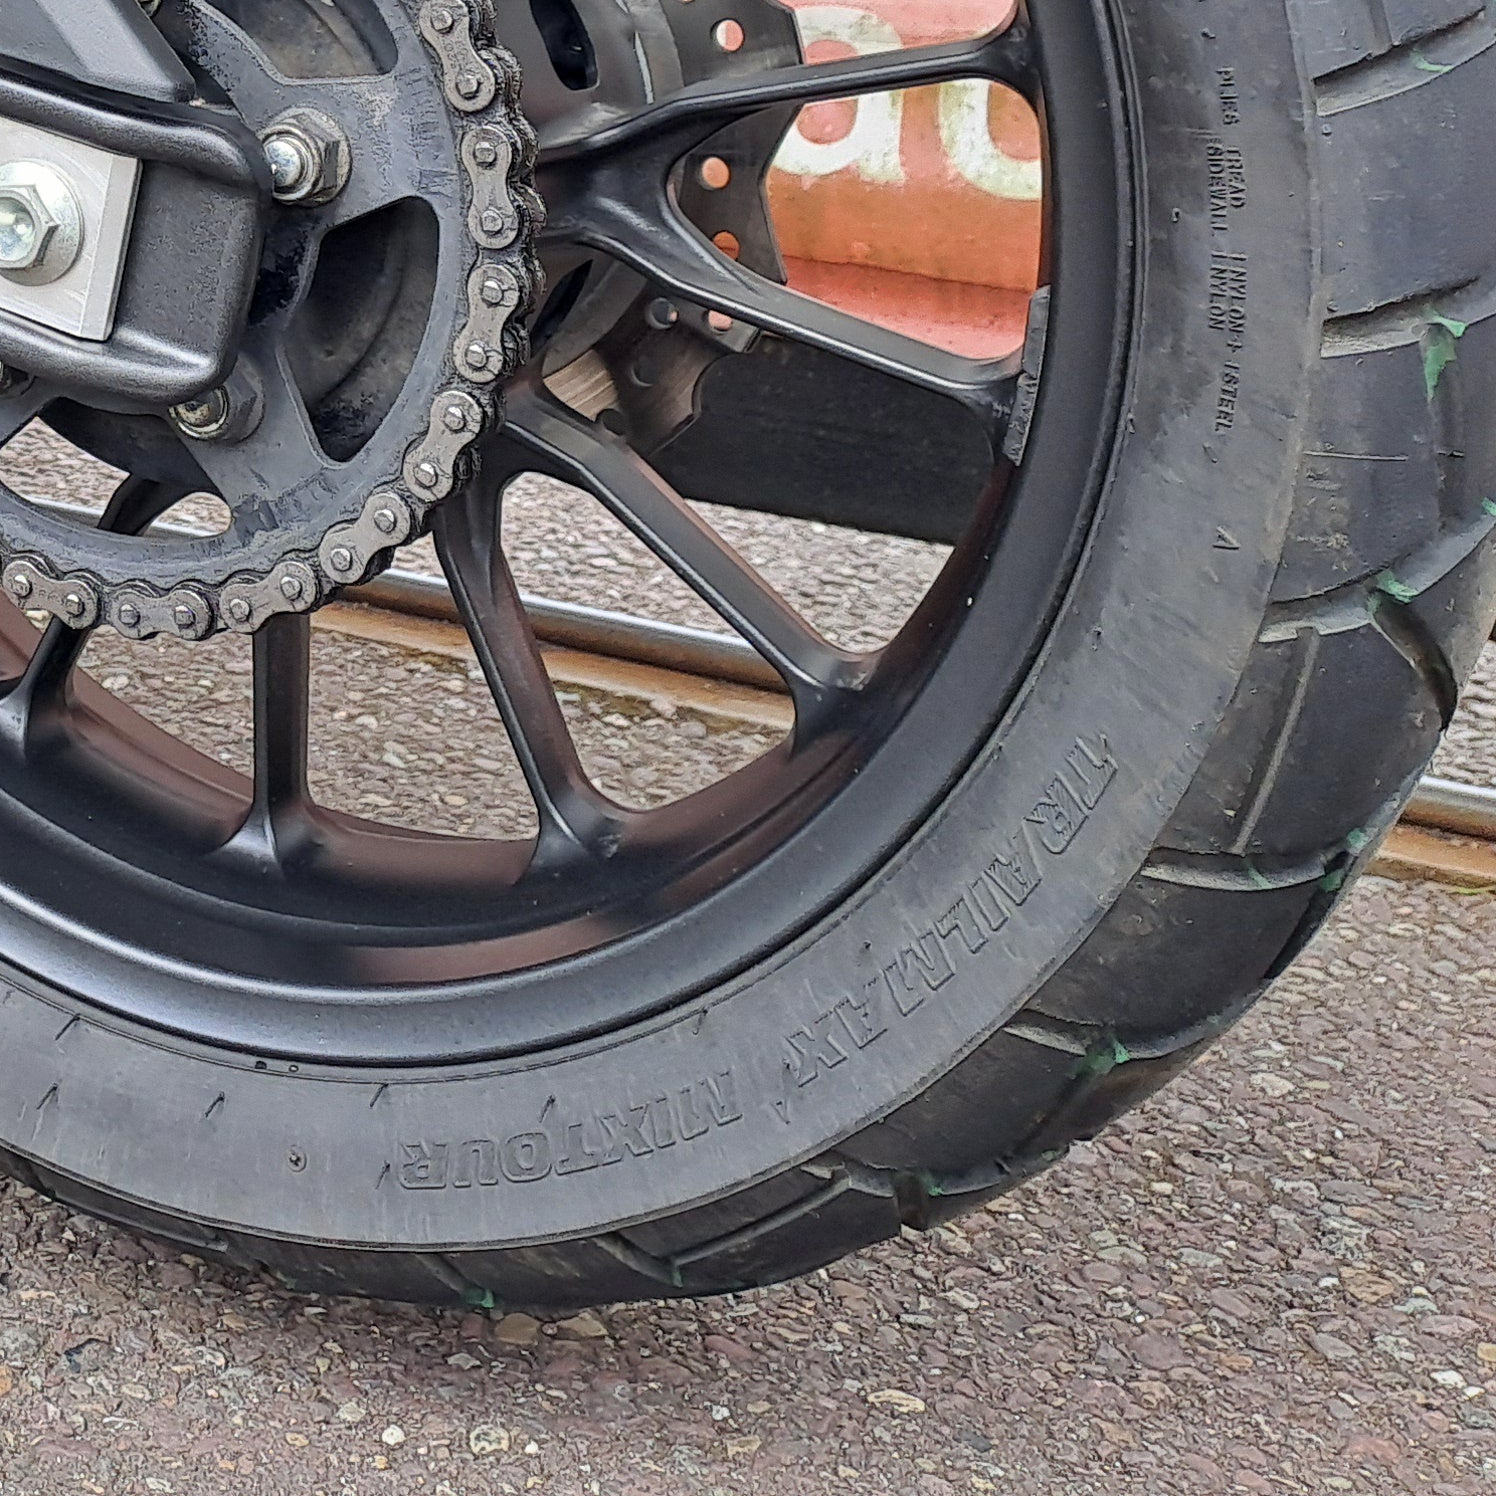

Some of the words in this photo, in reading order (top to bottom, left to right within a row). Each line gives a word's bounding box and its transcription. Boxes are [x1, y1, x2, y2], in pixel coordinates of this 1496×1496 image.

[1226, 146, 1247, 210] TREAD
[785, 731, 1118, 1085] TRAILMAX
[399, 1071, 743, 1189] MIXTOUR
